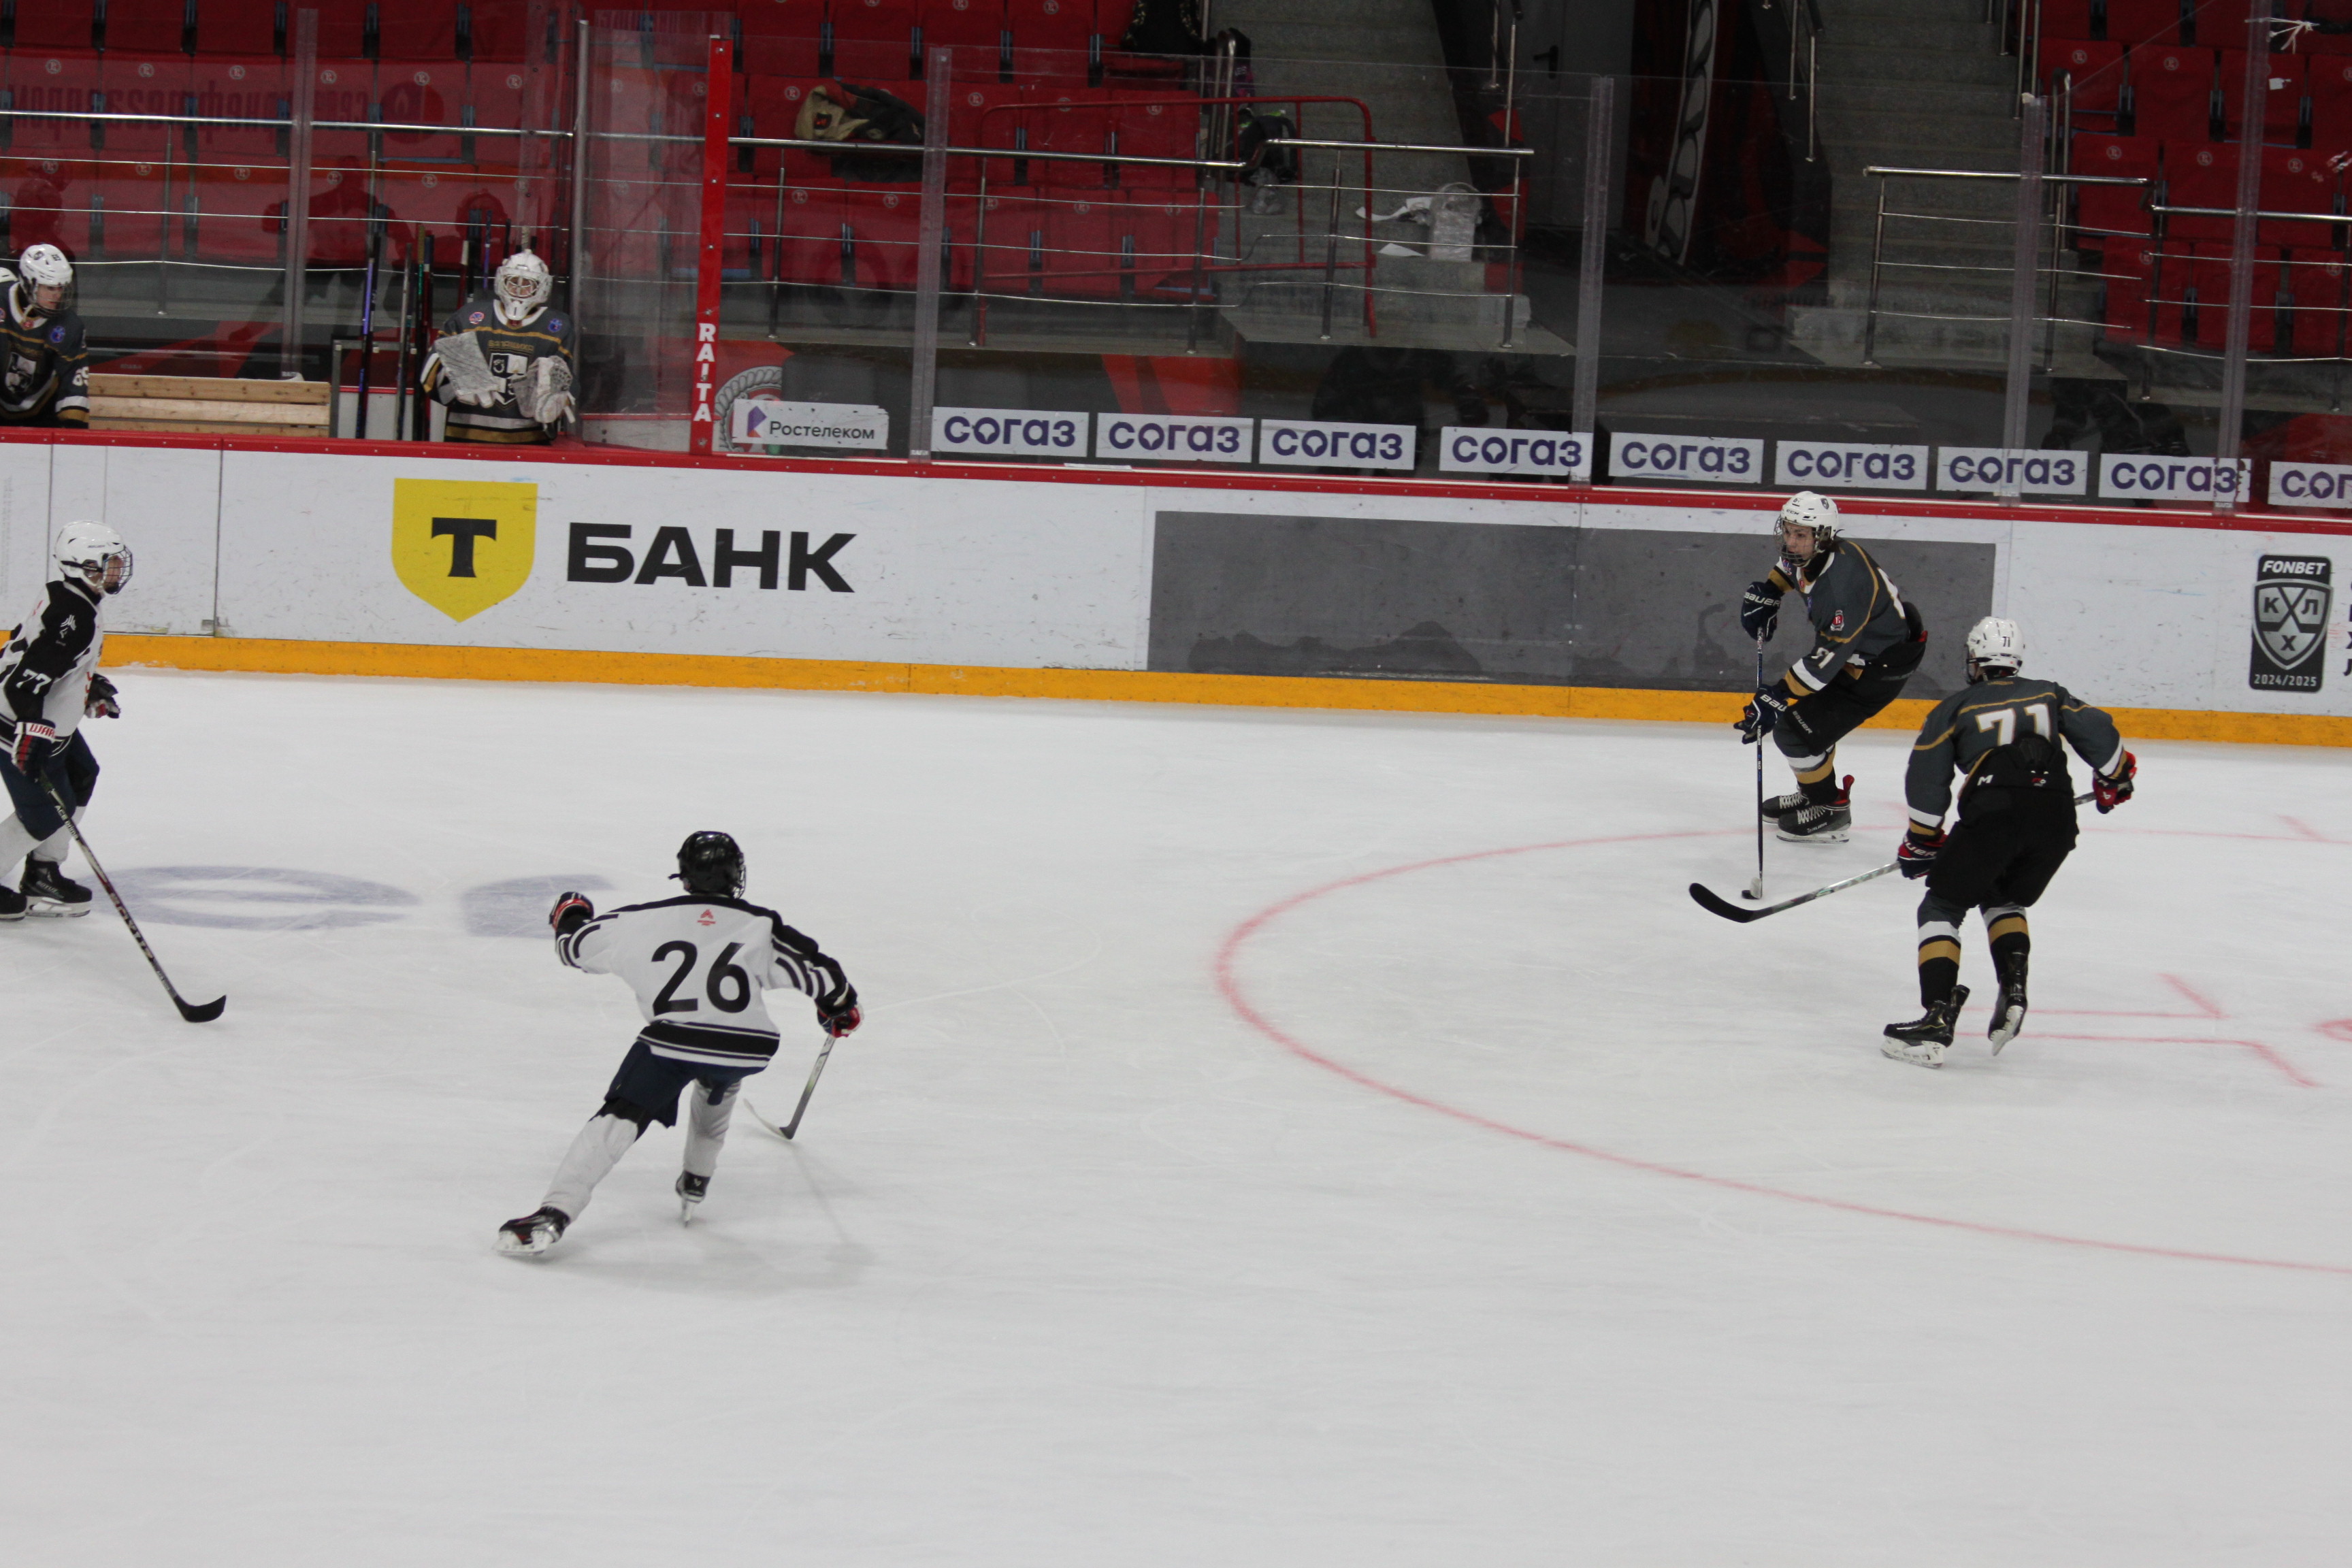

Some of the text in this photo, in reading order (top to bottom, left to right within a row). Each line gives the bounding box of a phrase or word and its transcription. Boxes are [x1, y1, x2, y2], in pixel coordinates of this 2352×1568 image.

[693, 323, 717, 422] RAITA
[770, 421, 875, 440] Ростелеком
[567, 522, 858, 593] БАНК
[2262, 560, 2327, 575] FONBET
[2301, 599, 2319, 615] Л
[2002, 636, 2011, 648] 71
[16, 668, 52, 695] 77
[2254, 674, 2317, 687] 2024/2025
[1975, 702, 2053, 747] 71
[651, 939, 751, 1017] 26
